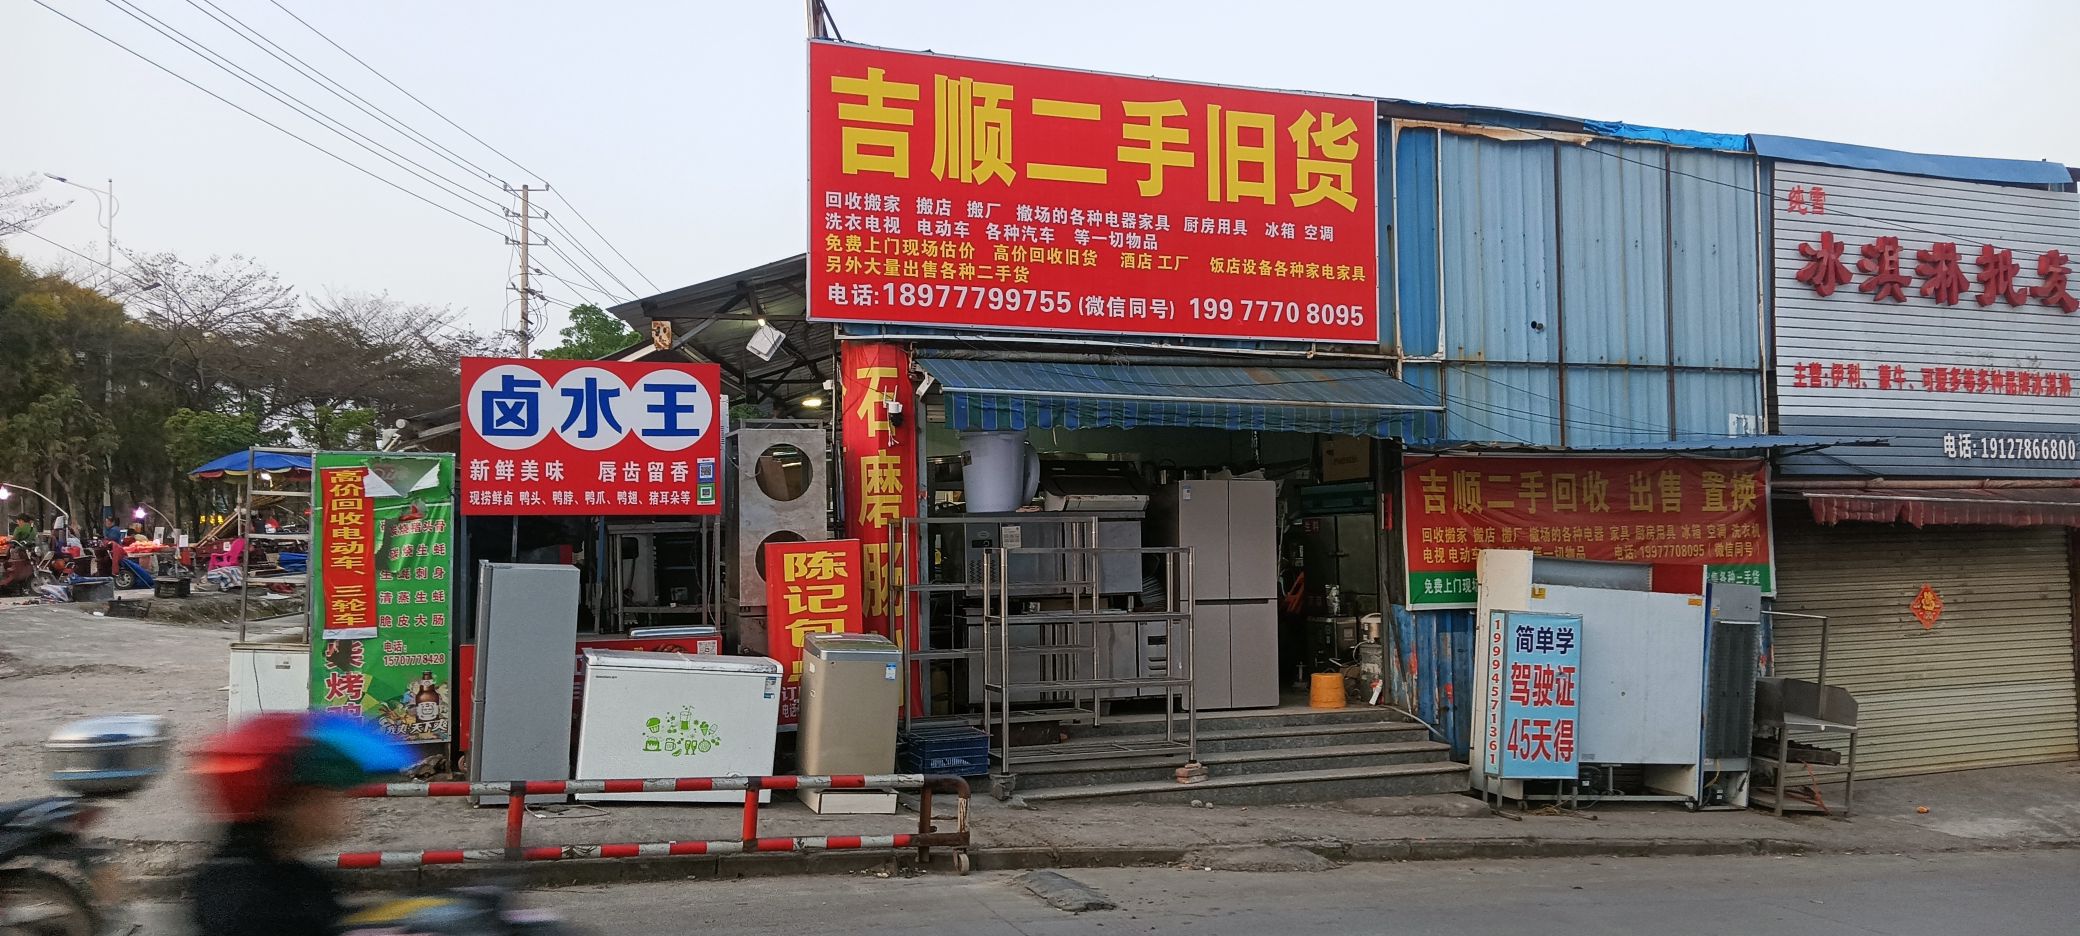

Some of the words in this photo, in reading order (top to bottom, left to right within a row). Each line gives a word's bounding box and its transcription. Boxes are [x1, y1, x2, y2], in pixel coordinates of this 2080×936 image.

[831, 67, 1359, 212] 吉顺二手旧货
[825, 192, 900, 212] 回收搬家
[917, 197, 951, 217] 搬店
[967, 200, 1001, 219] 搬厂
[1016, 204, 1170, 231] 撤场的各种电器家具
[1184, 216, 1248, 236] 厨房用具
[1265, 222, 1295, 239] 冰箱
[1305, 225, 1334, 242] 空调
[825, 212, 900, 234] 洗衣电视
[917, 219, 970, 238] 电动车
[986, 223, 1055, 244] 各种汽车
[1074, 228, 1158, 250] 等一切物品
[825, 233, 975, 259] 免费上门现场估价
[993, 244, 1098, 266] 高价回收旧货
[1120, 252, 1152, 270] 酒店
[1158, 255, 1189, 271] 工厂
[1209, 256, 1366, 282] 饭店设备各种家电家具
[826, 255, 1029, 283] 另外大量出售各种二手货
[1796, 230, 2080, 314] 冰淇淋批发
[482, 375, 700, 438] 卤水王
[469, 459, 564, 482] 新鲜美味
[598, 461, 690, 483] 唇齿留香
[469, 491, 513, 506] 现捞鲜卤
[1419, 470, 1610, 514] 吉顺二手回收
[1629, 471, 1682, 513] 出售
[1702, 472, 1757, 513] 置换
[1422, 527, 1467, 544] 回收搬家
[1473, 526, 1495, 543] 搬店
[1502, 527, 1523, 543] 搬厂
[1610, 526, 1631, 541] 家具
[1635, 525, 1676, 540] 厨房用具
[1681, 525, 1701, 539] 冰箱
[1707, 524, 1727, 539] 空调
[1732, 523, 1760, 538] 洗衣机
[1423, 547, 1446, 564] 电视
[379, 615, 445, 627] 脆皮大肠
[1516, 624, 1574, 655] 简单学
[383, 655, 446, 666] 15707778428
[1489, 619, 1501, 764] 19994571361
[1510, 662, 1576, 707] 驾驶证
[1507, 718, 1574, 763] 45天得
